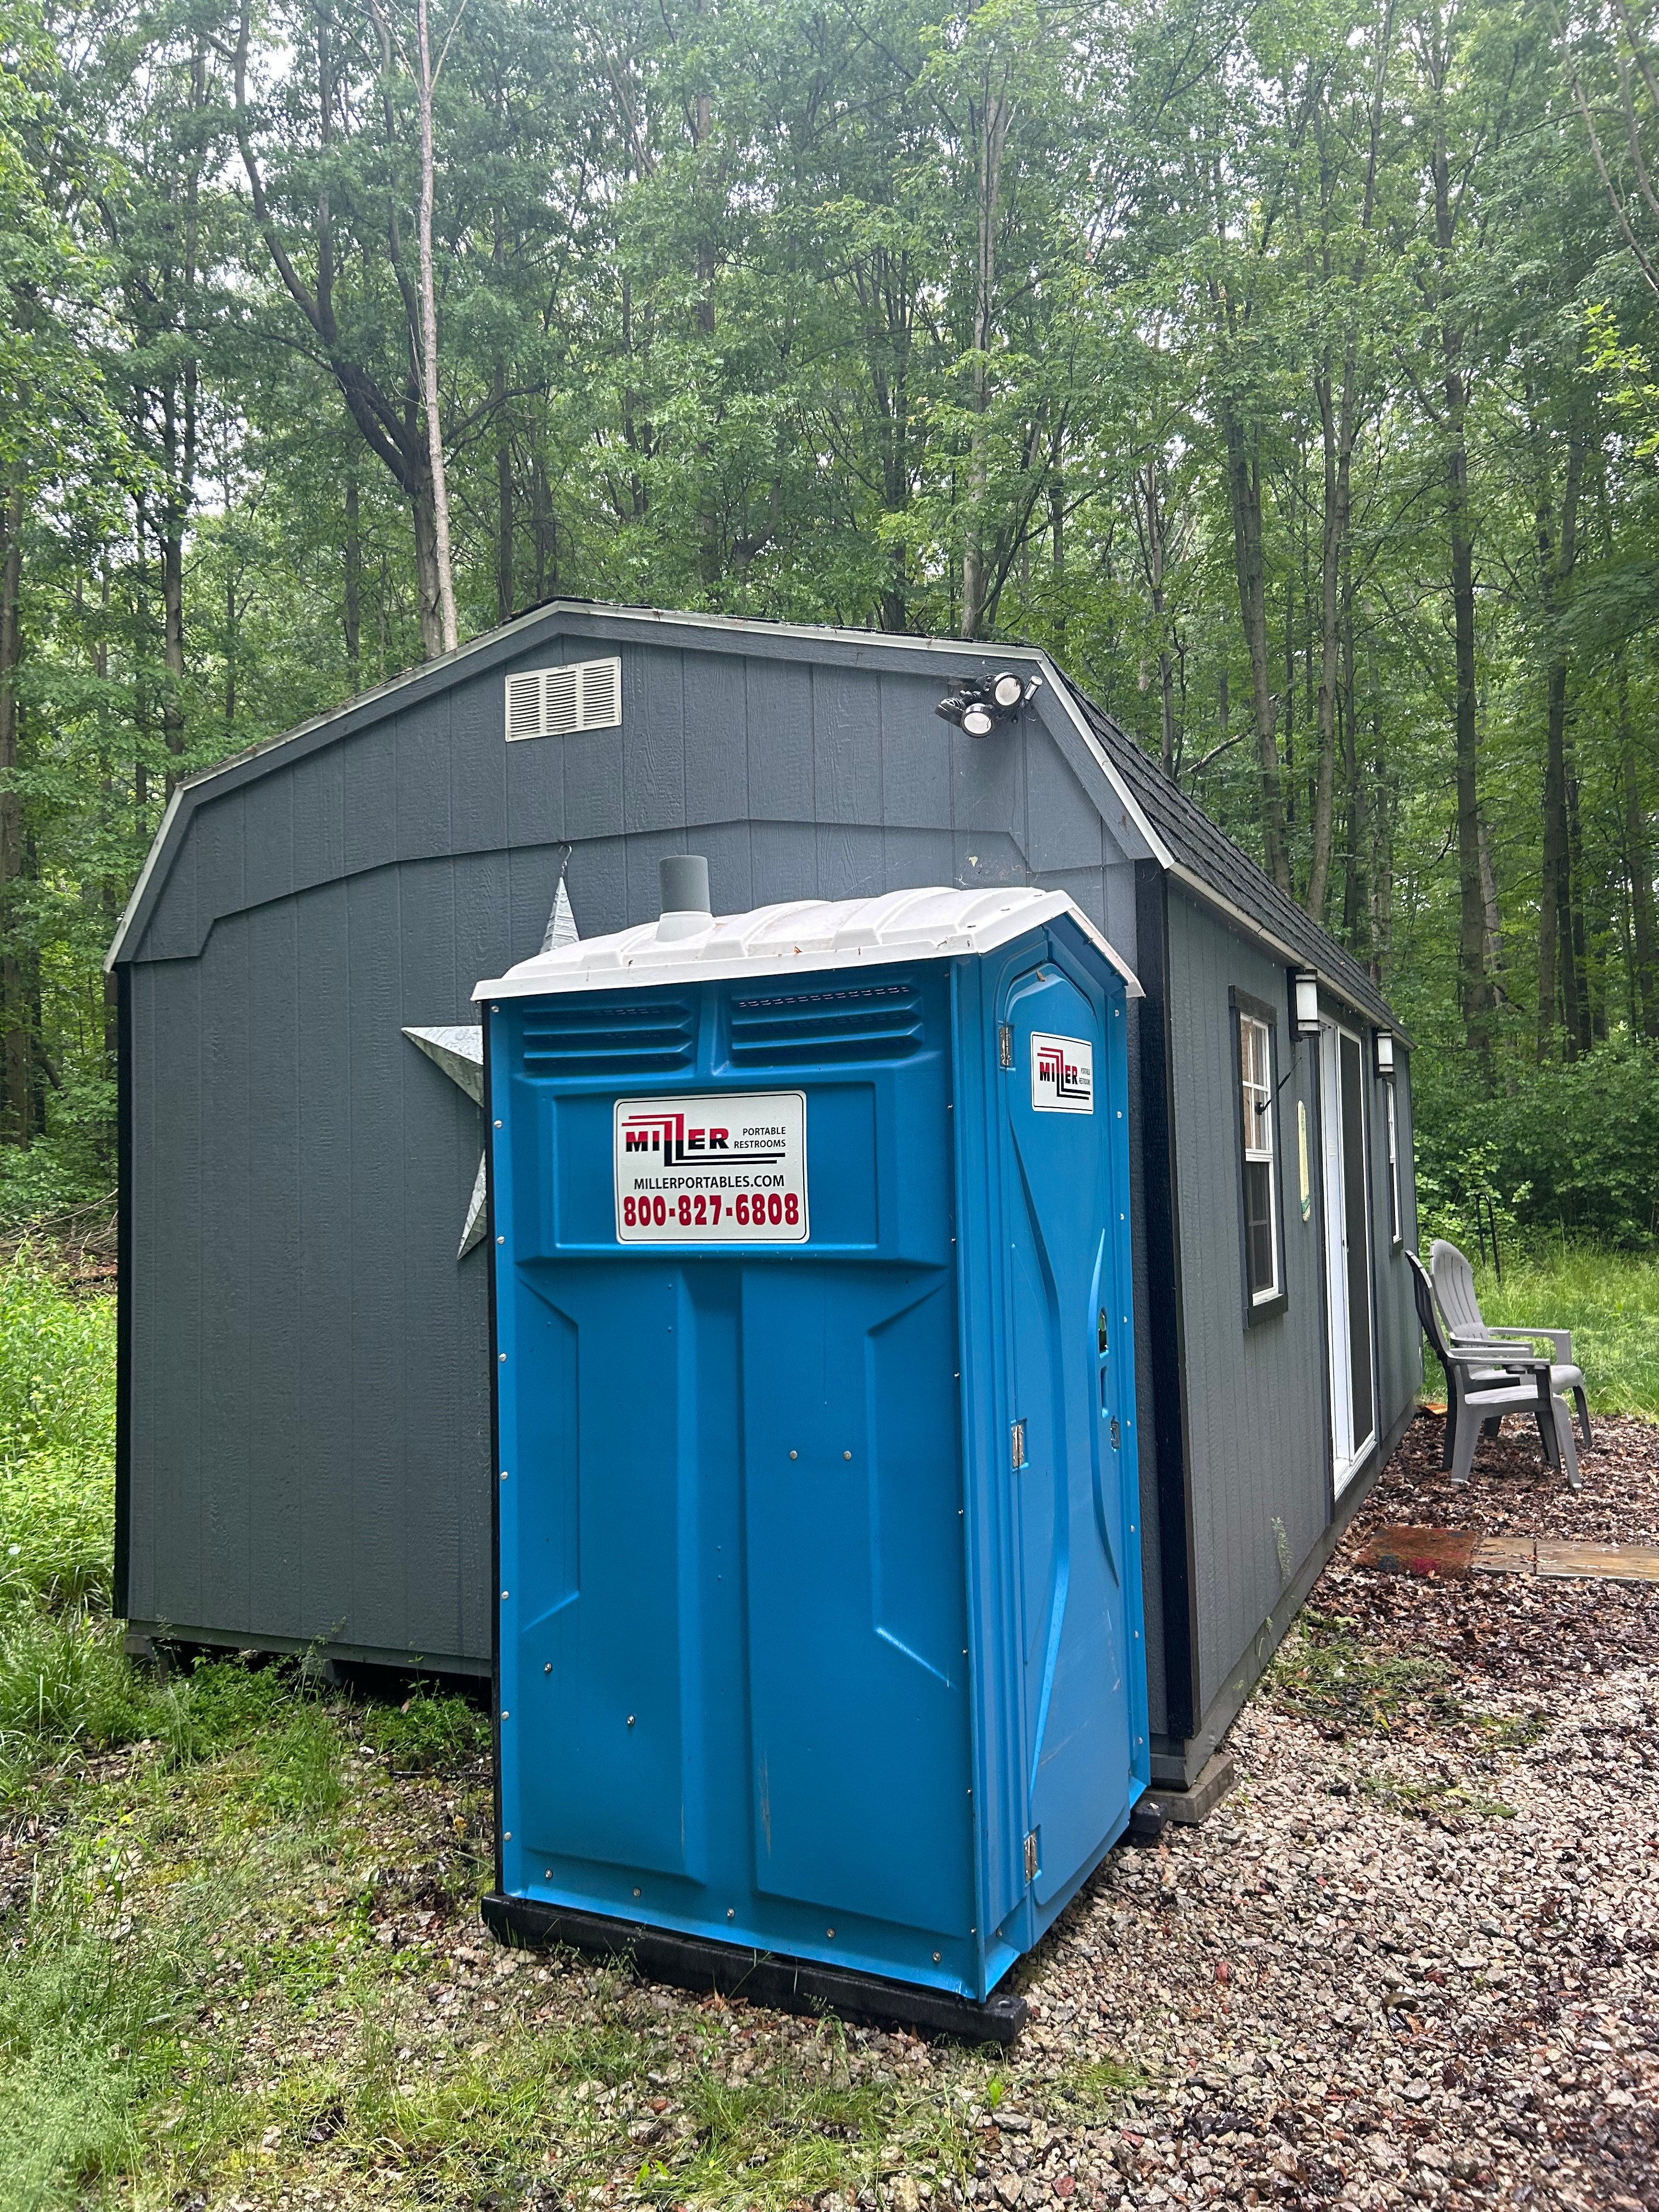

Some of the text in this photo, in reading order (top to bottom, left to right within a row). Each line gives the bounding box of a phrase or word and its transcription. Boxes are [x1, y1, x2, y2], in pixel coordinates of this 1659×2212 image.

[742, 1127, 786, 1136] PORTABLE
[625, 1114, 730, 1166] MILLER
[734, 1139, 786, 1149] RESTROOMS
[634, 1175, 785, 1190] MILLERPORTABLES.COM
[623, 1193, 799, 1226] 800-827-6808
